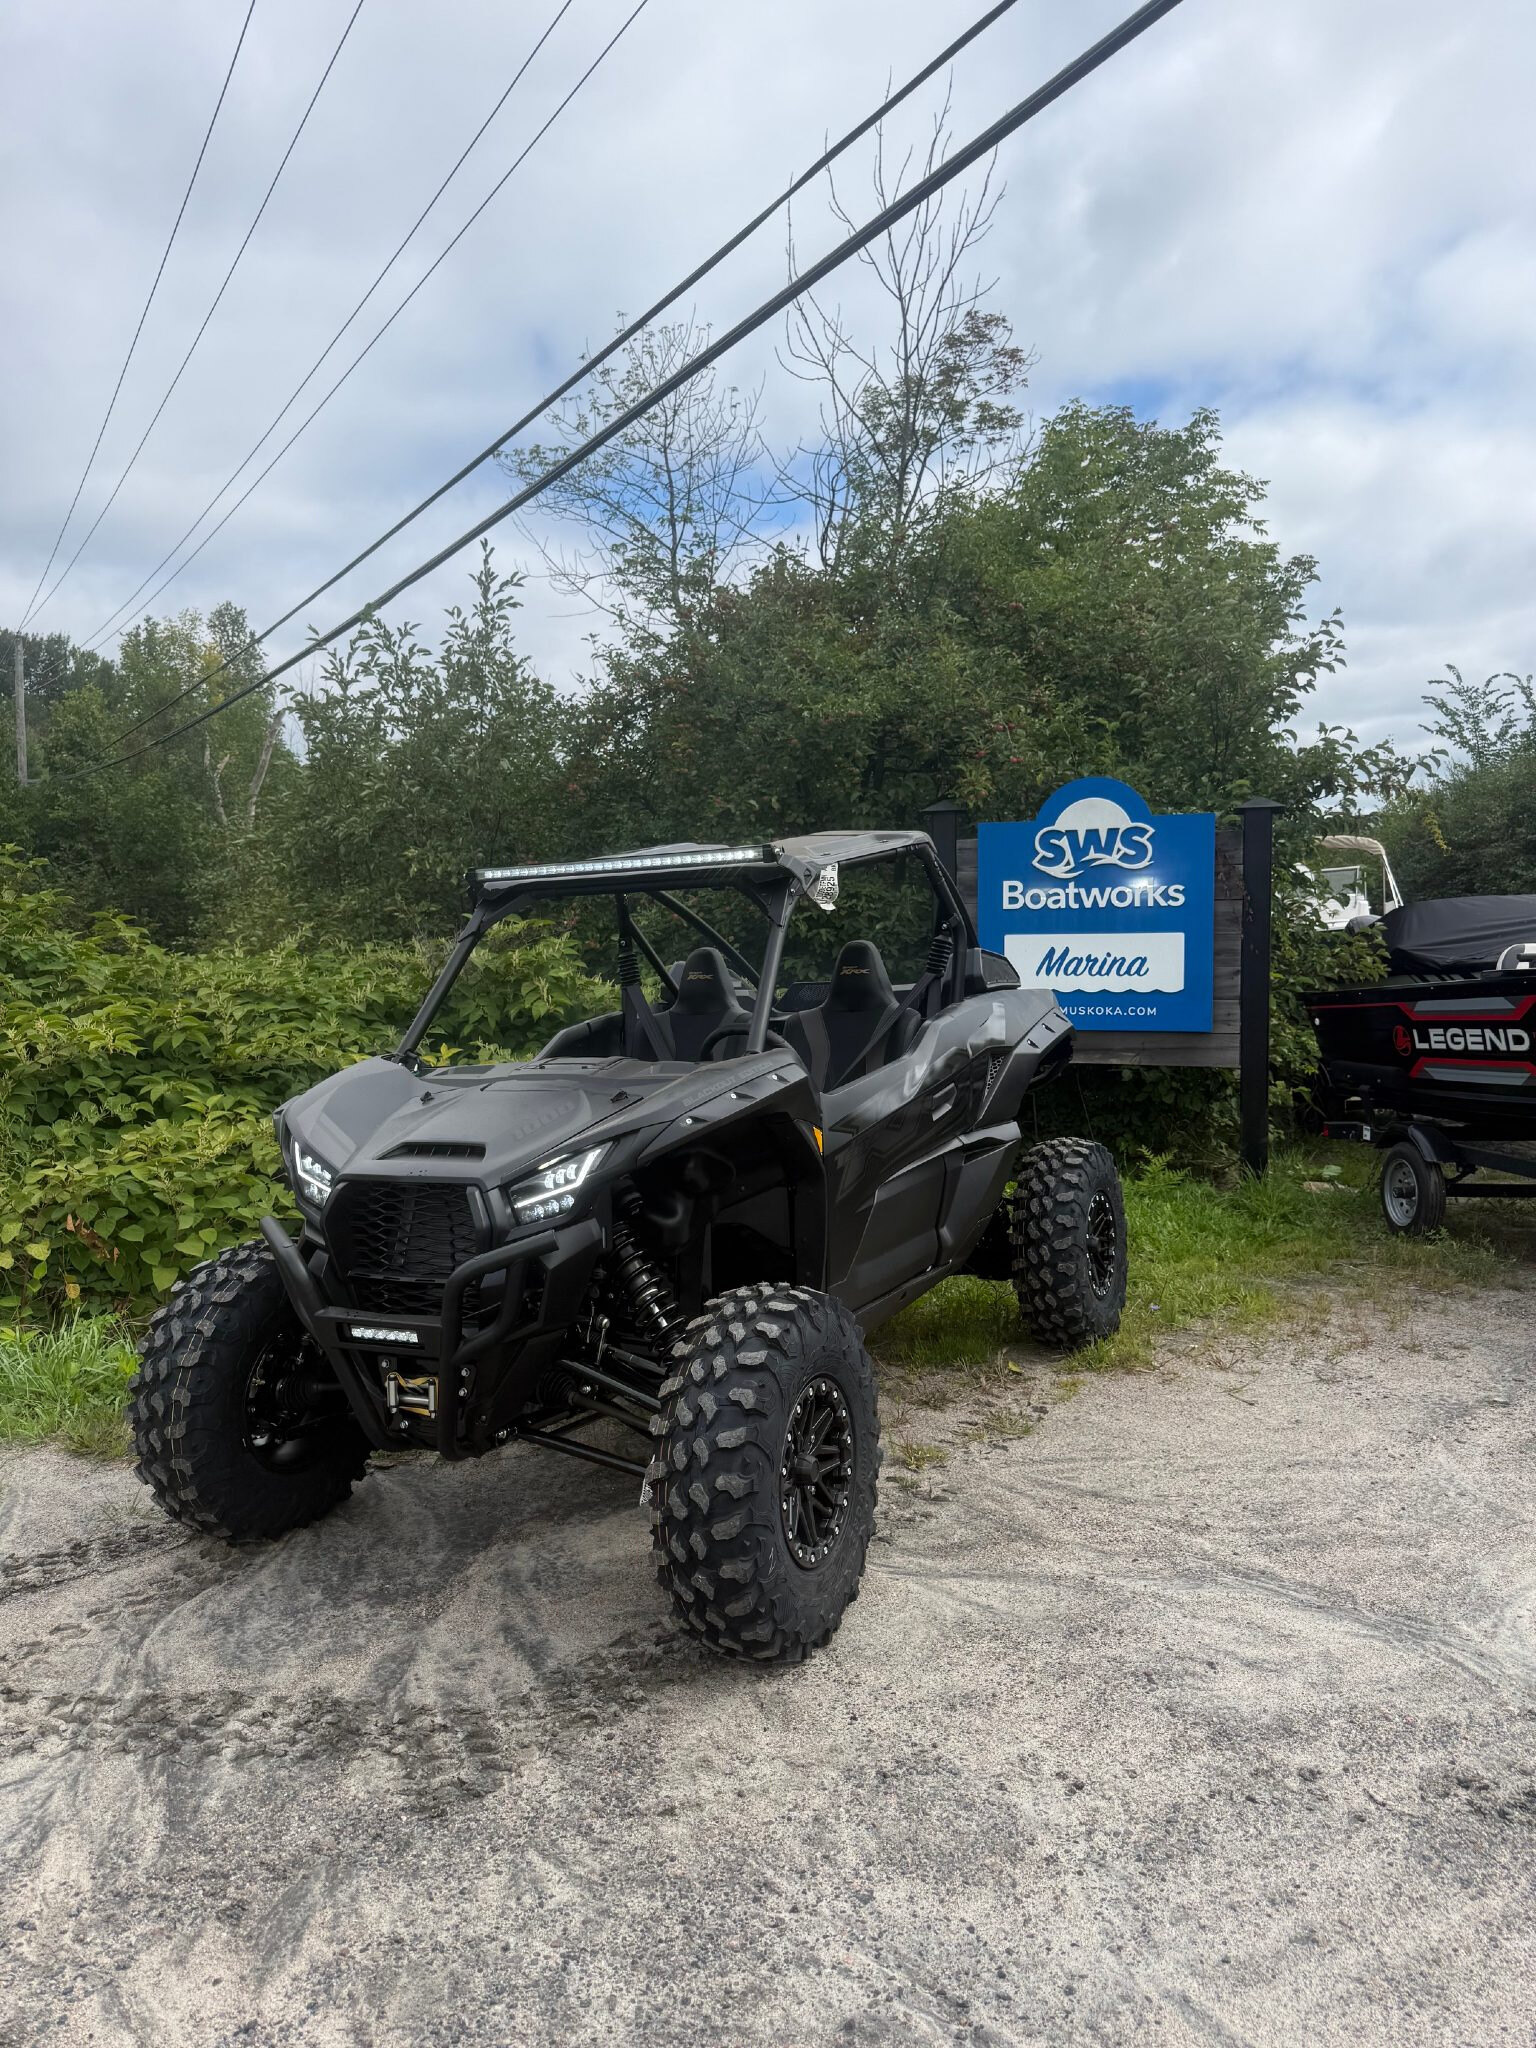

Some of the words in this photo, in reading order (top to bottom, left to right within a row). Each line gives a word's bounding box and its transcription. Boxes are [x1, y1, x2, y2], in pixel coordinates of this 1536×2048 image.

[1032, 822, 1155, 877] SWS
[1002, 880, 1186, 910] Boatworks
[1035, 946, 1150, 977] Marina
[1412, 1027, 1530, 1051] LEGEND
[682, 1075, 737, 1107] BLACKOUT
